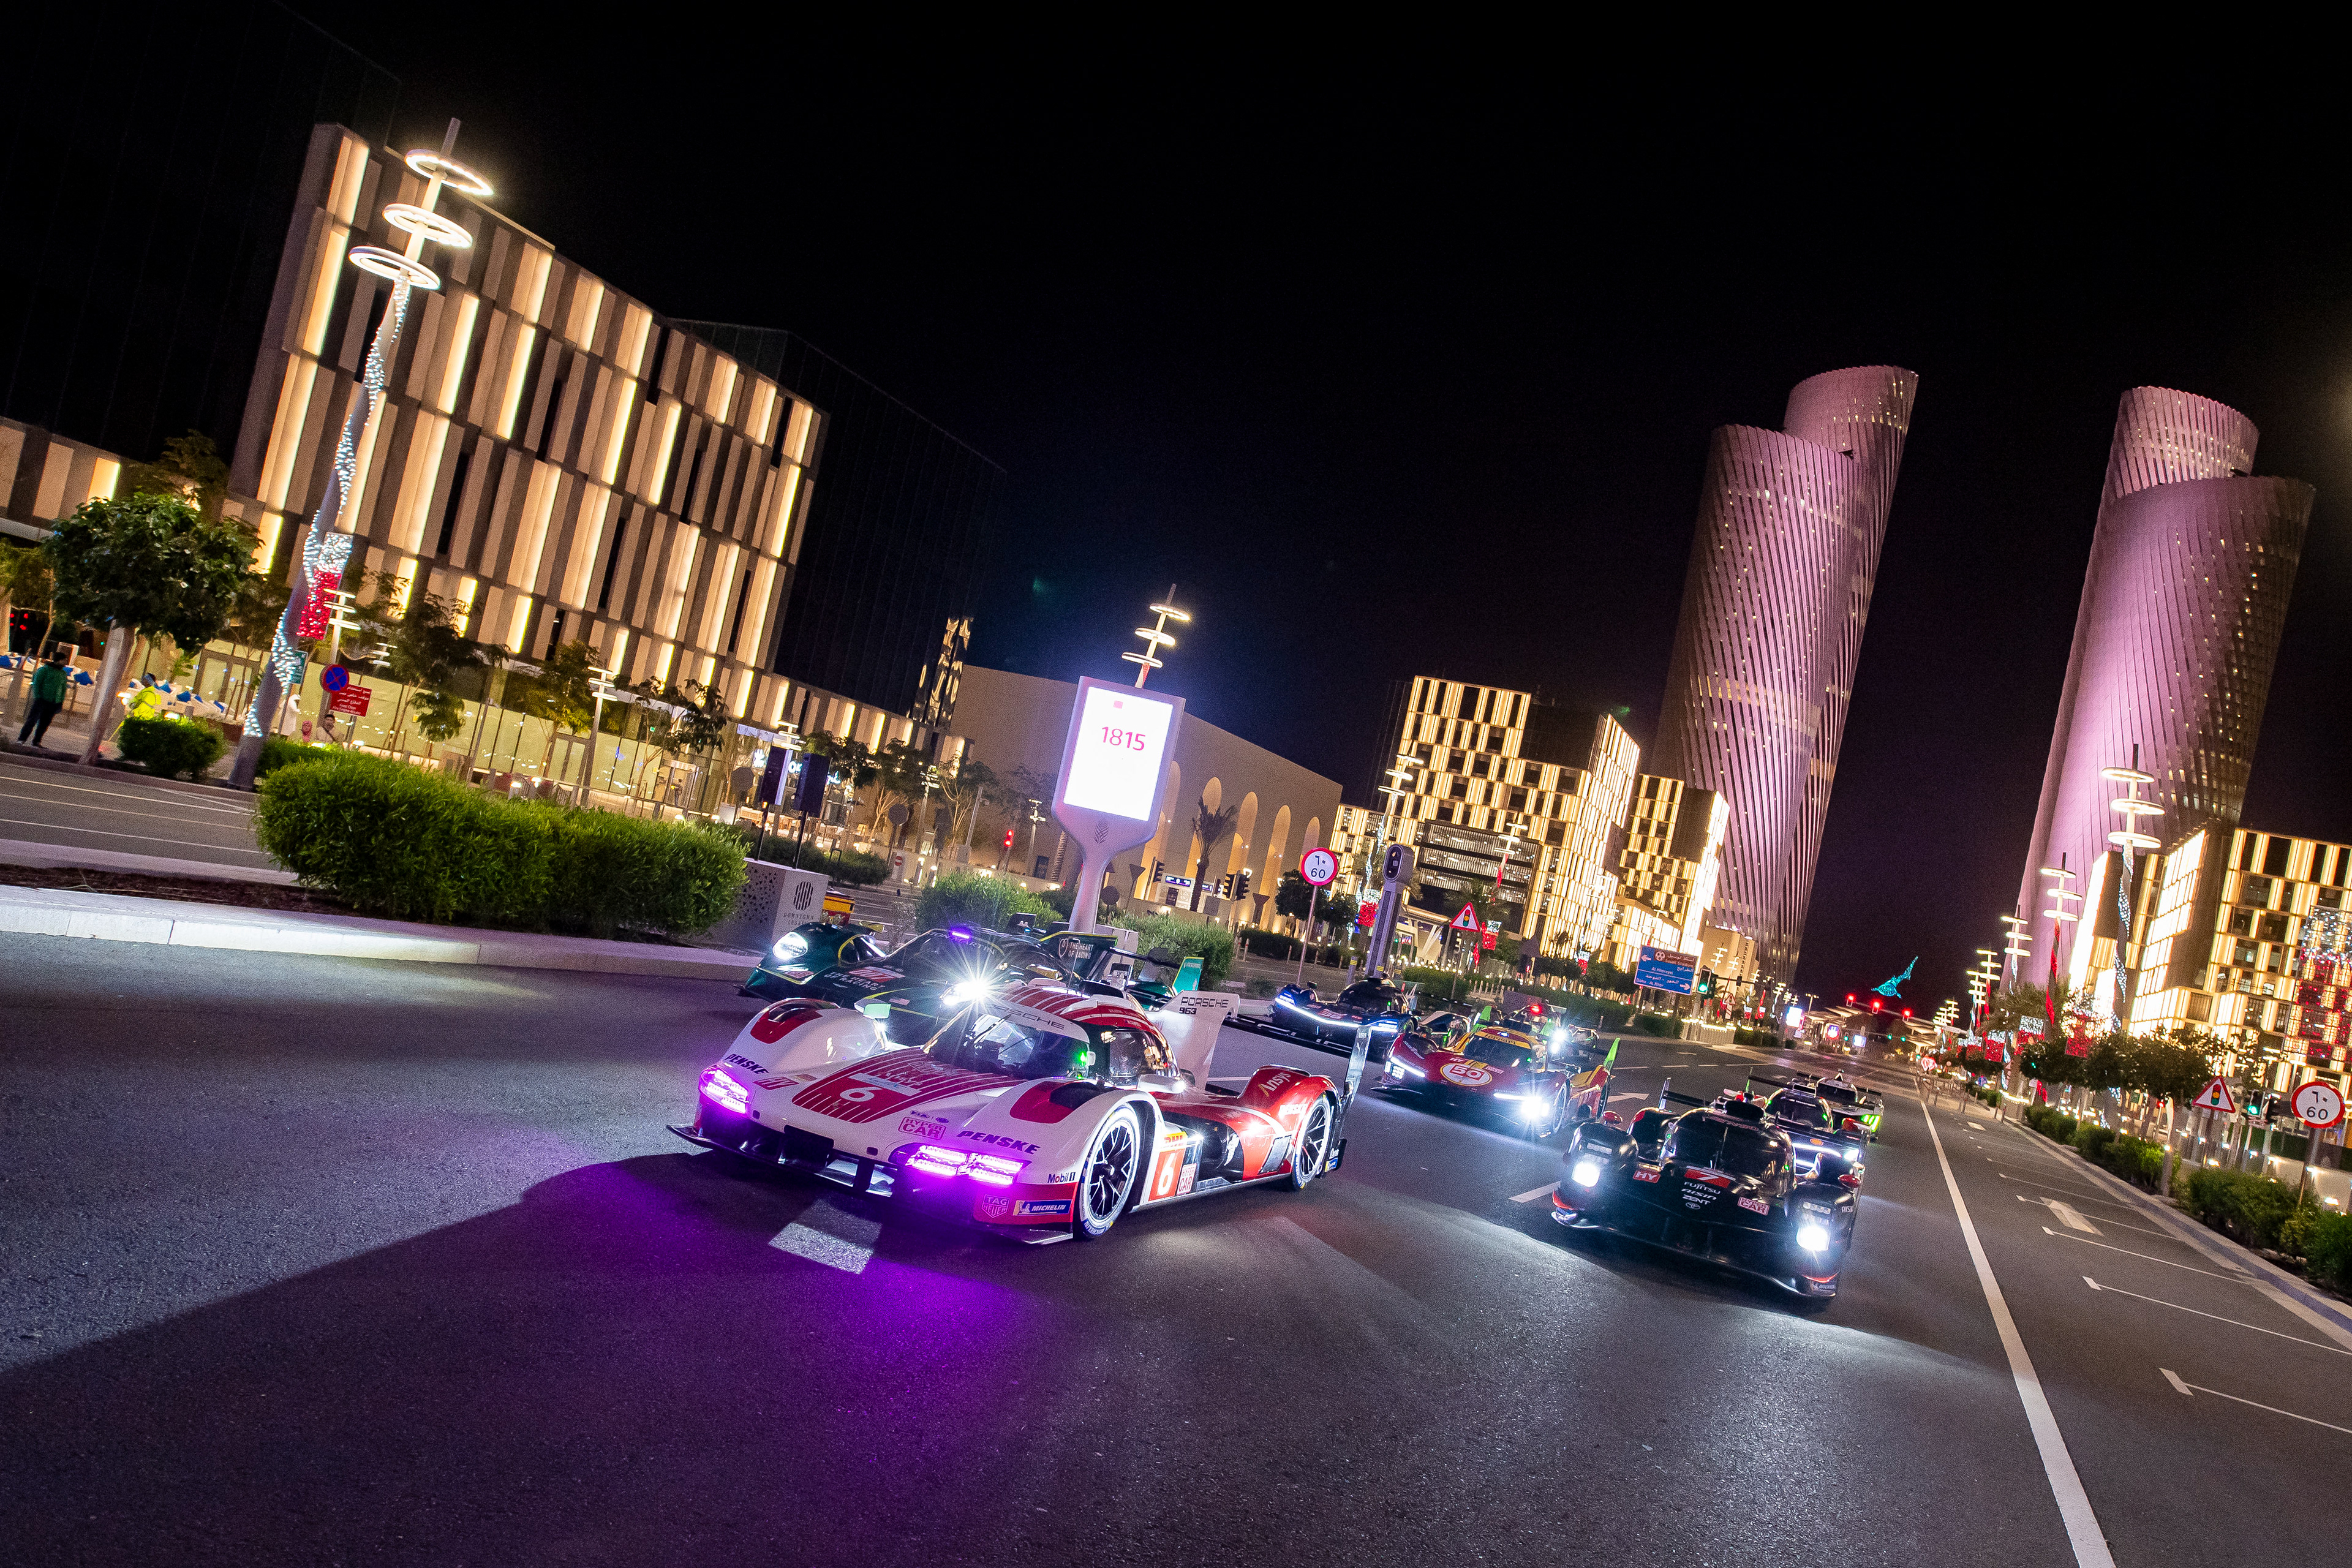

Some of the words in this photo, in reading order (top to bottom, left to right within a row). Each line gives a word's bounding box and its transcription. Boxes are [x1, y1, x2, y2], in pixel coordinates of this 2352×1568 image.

[1102, 727, 1146, 751] 1815
[1311, 868, 1325, 878] 60
[842, 978, 878, 990] RACING
[851, 977, 886, 988] HEART
[1181, 997, 1229, 1008] PORSCHE
[724, 1054, 769, 1074] PENSKE
[1451, 1066, 1483, 1079] 50
[1257, 1072, 1291, 1098] Ansys
[840, 1087, 882, 1102] 6
[2307, 1106, 2328, 1120] 60
[902, 1123, 940, 1139] CAR
[905, 1118, 943, 1131] HYPER
[957, 1131, 1040, 1155] PENSKE
[1047, 1172, 1068, 1183] Mobil
[1158, 1152, 1176, 1196] 6
[1635, 1171, 1657, 1180] HY
[1697, 1171, 1719, 1181] 7
[1178, 1176, 1193, 1193] CAR
[1684, 1182, 1721, 1194] FUJITSU
[986, 1196, 1008, 1205] TAG
[1682, 1194, 1711, 1205] ZENT
[983, 1205, 1006, 1215] HEUER
[1741, 1200, 1765, 1213] CAR
